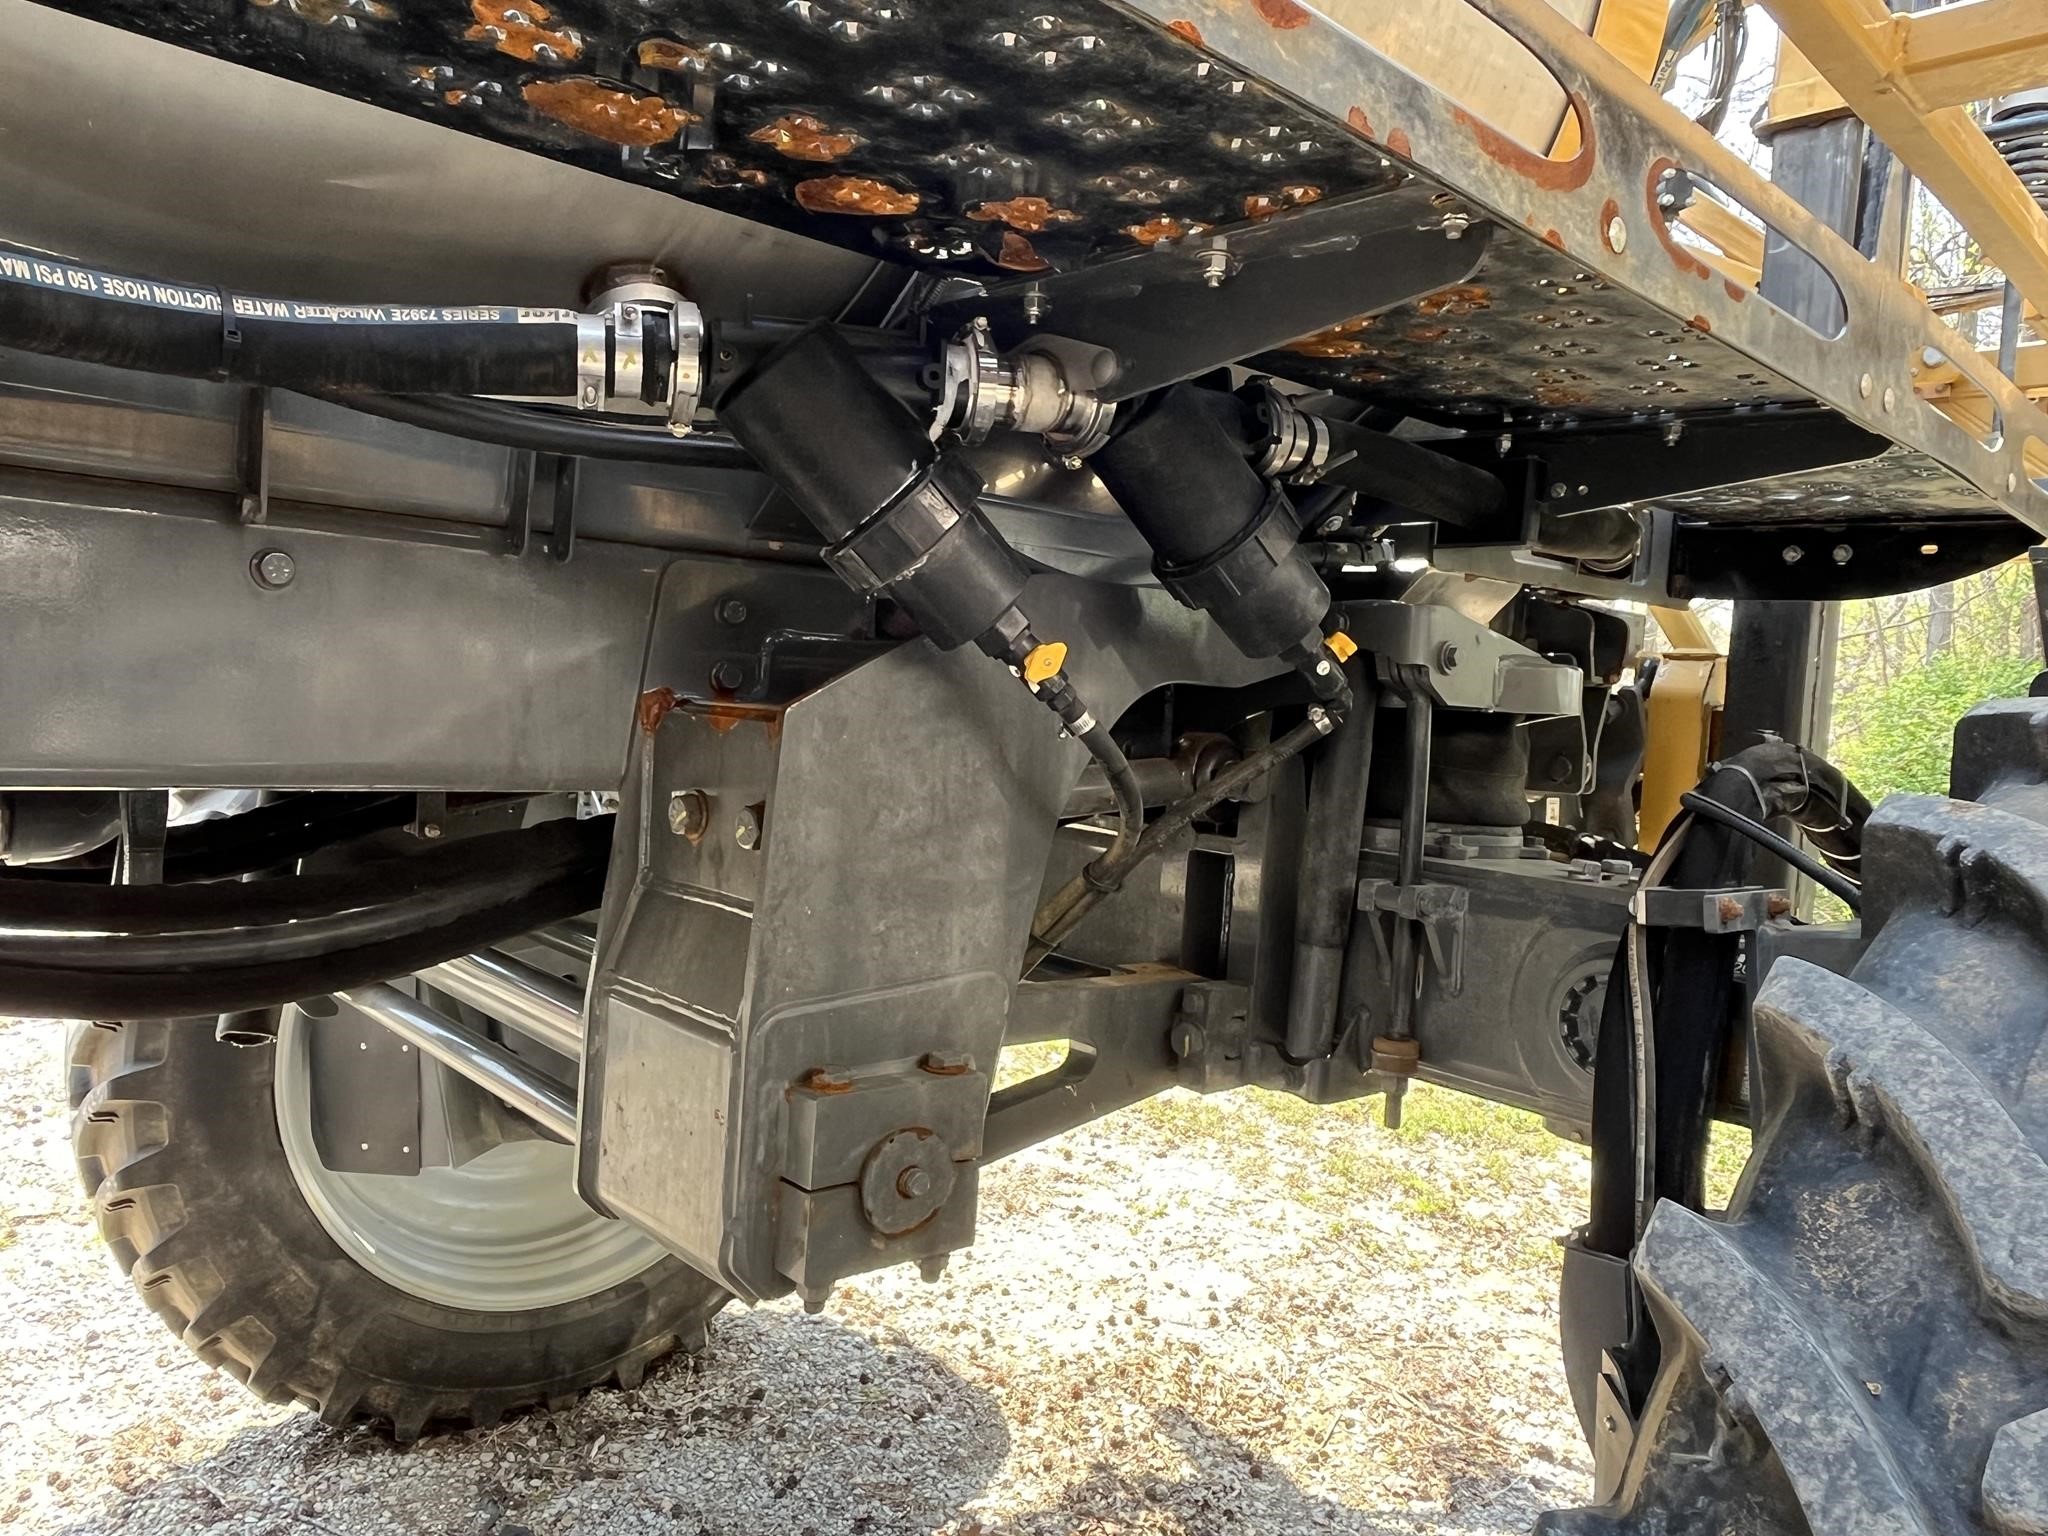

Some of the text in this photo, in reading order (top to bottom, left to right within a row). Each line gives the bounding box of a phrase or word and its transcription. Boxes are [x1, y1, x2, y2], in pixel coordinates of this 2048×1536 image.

[0, 255, 31, 280] MA
[33, 262, 65, 287] PSI
[67, 270, 98, 291] 150
[101, 276, 152, 301] HOSE
[232, 297, 290, 318] WATER
[391, 308, 438, 322] 7392E
[442, 308, 500, 322] SERIES
